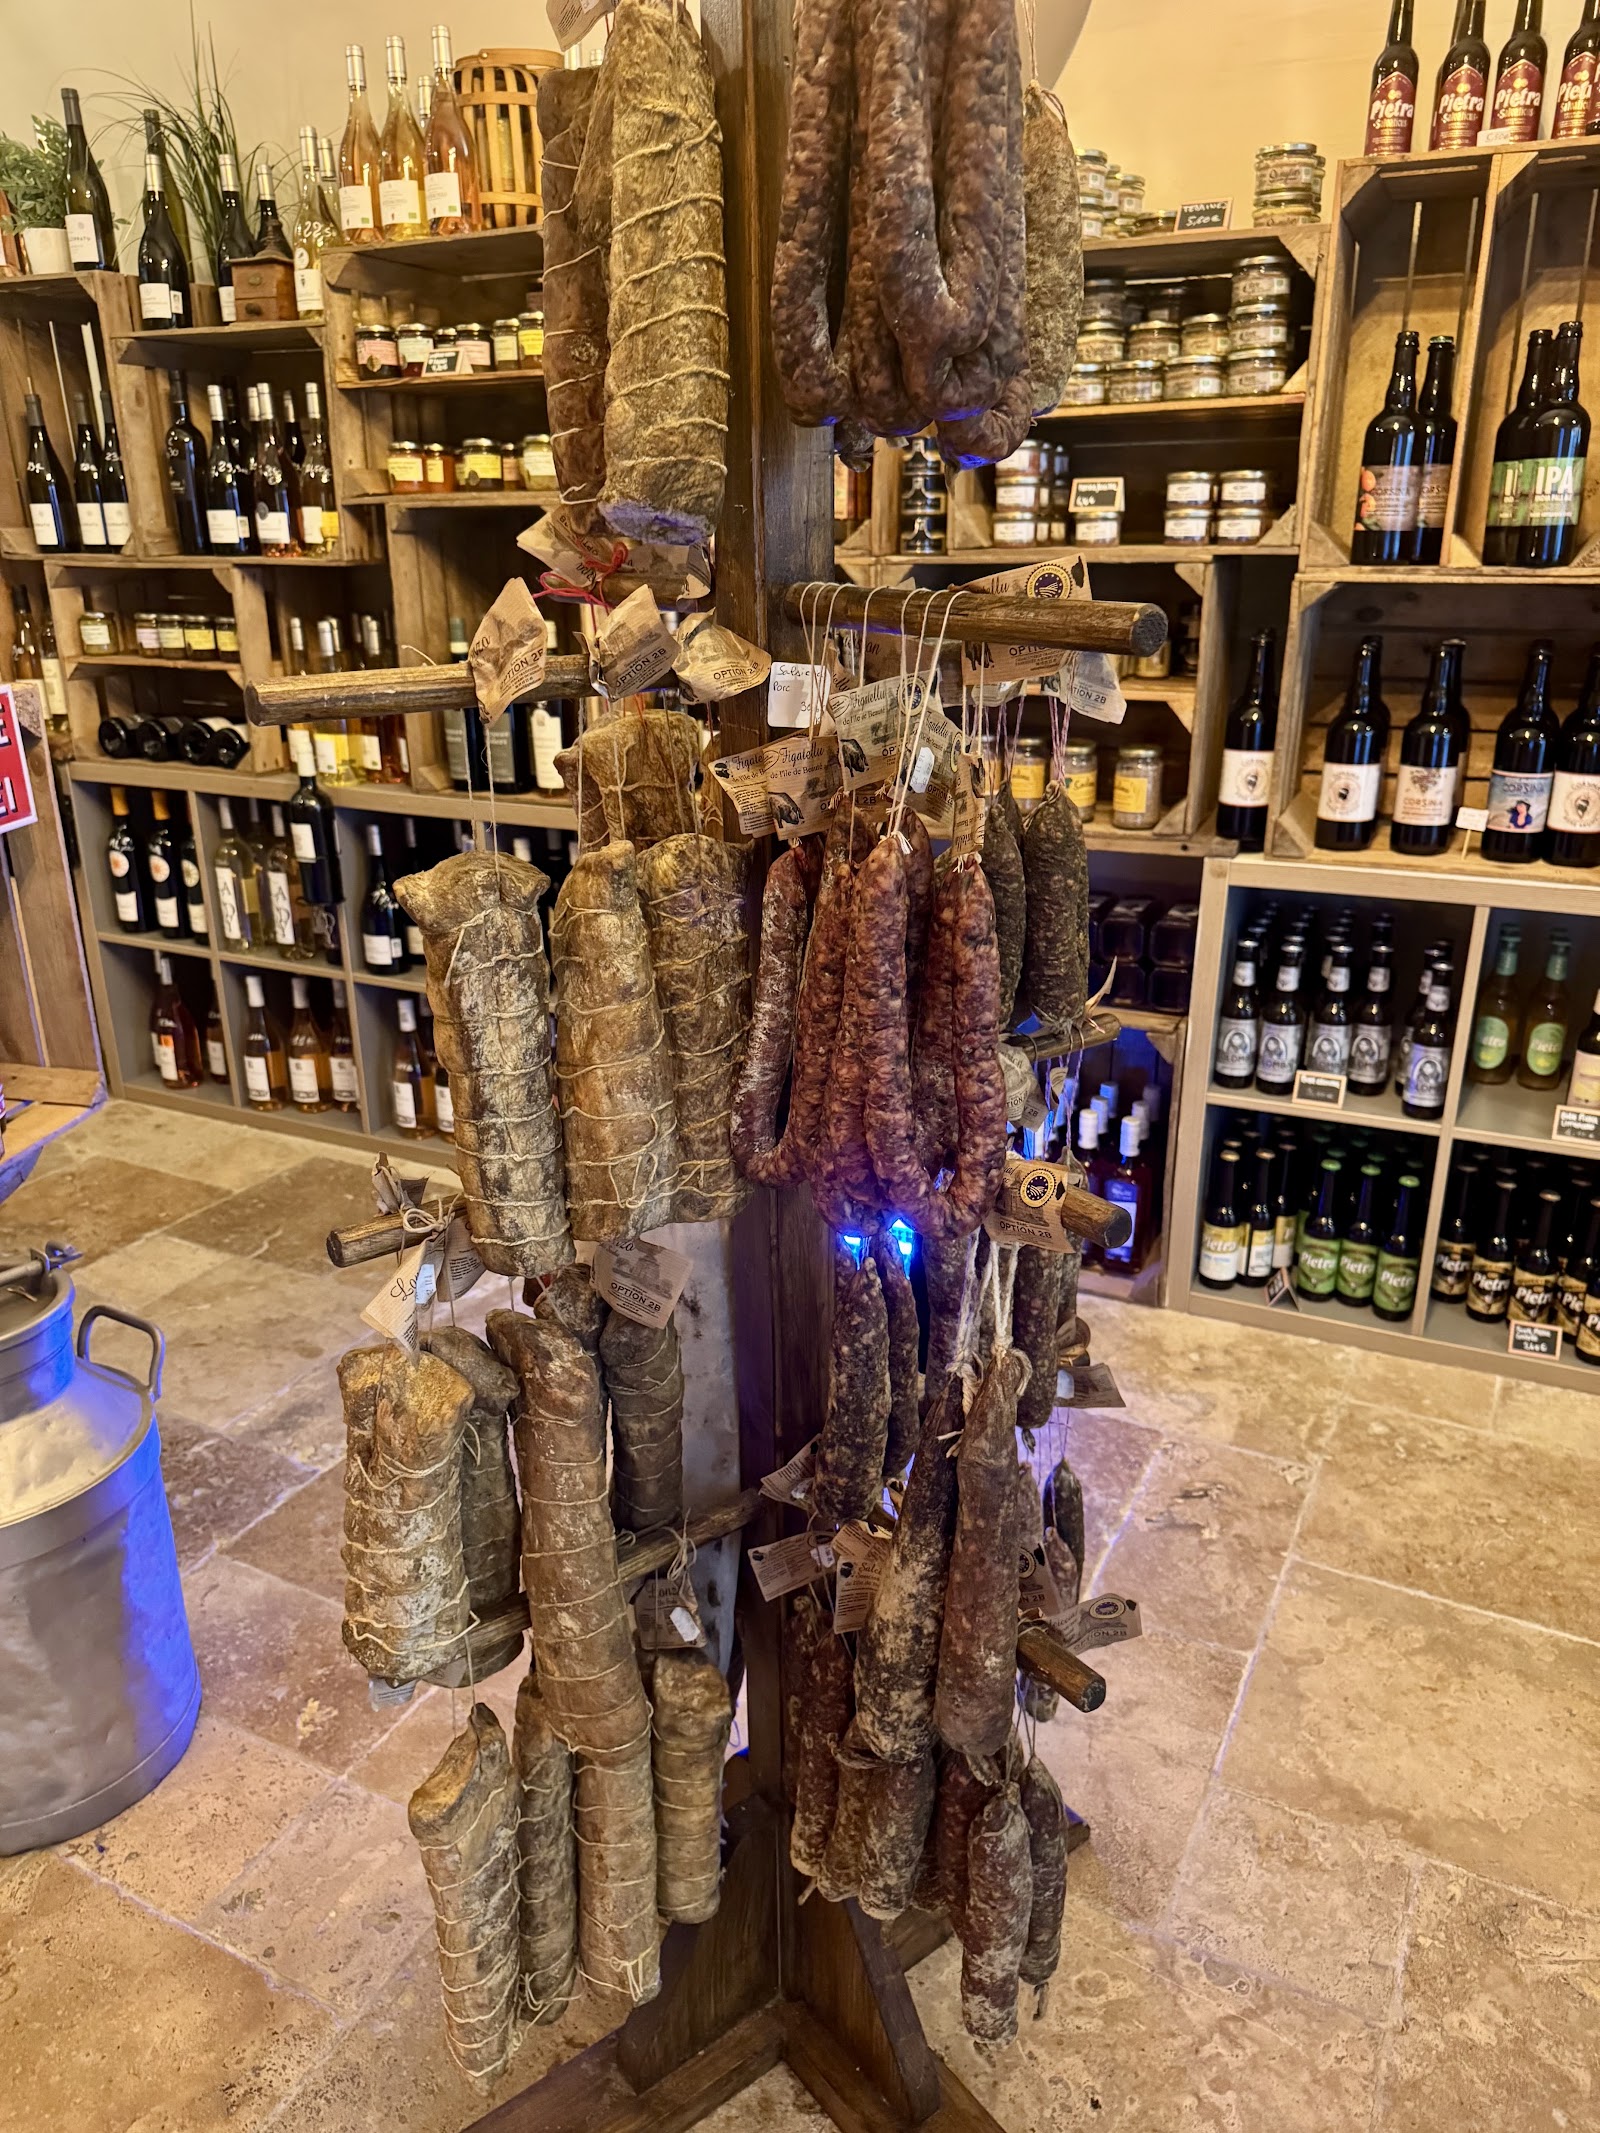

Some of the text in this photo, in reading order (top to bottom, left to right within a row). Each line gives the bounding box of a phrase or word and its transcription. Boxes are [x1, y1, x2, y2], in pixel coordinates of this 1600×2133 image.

[1439, 94, 1484, 114] Pietra
[1495, 88, 1541, 110] Pietra
[1370, 99, 1414, 120] Pietra
[1535, 466, 1574, 495] IPA
[651, 647, 667, 659] 2B
[713, 661, 760, 680] OPTION 2B
[773, 680, 791, 692] Porc
[1073, 687, 1107, 704] TION 2B
[780, 740, 824, 765] Figatellu
[770, 771, 778, 780] de
[794, 767, 802, 776] de
[927, 783, 948, 802] OPTION
[1503, 782, 1546, 795] CORSINA
[863, 796, 876, 804] 2B
[1403, 799, 1443, 808] CORSINA
[1028, 1108, 1039, 1117] 2B
[999, 1222, 1053, 1240] OPTION 2B
[610, 1282, 662, 1313] OPTION 2B
[1562, 1292, 1584, 1313] Pie
